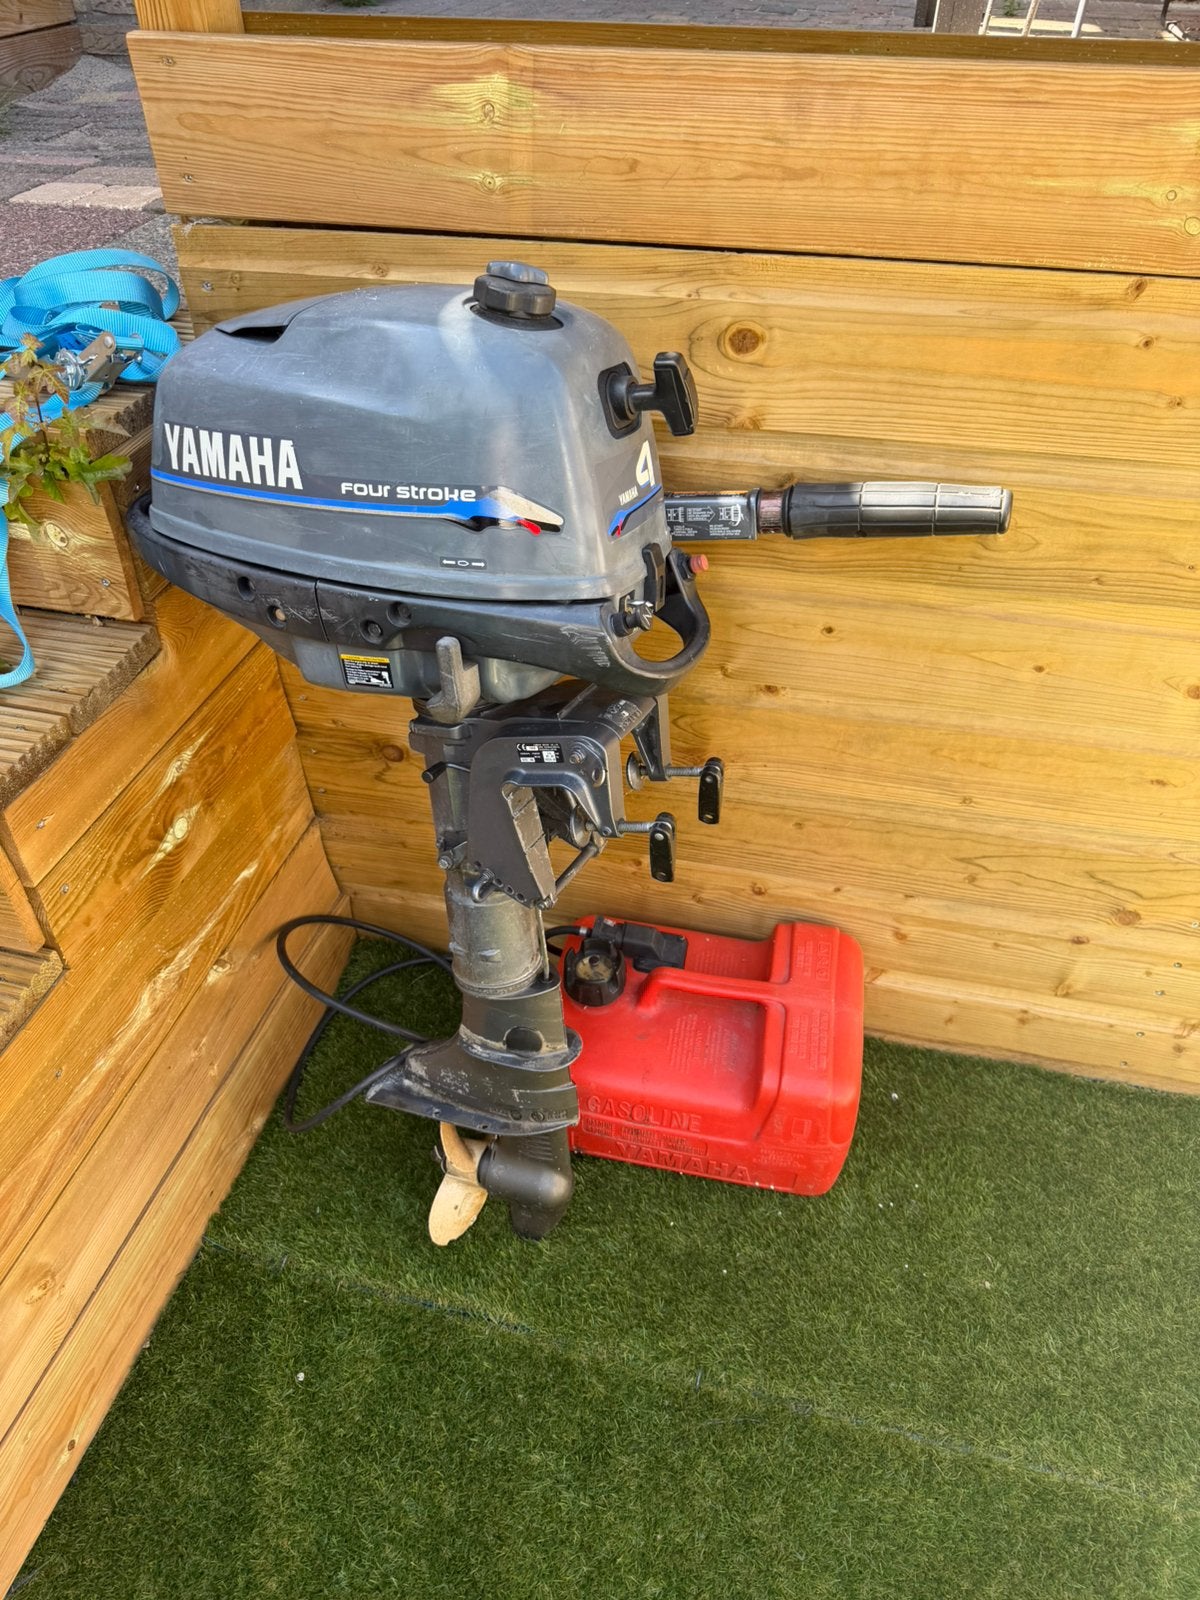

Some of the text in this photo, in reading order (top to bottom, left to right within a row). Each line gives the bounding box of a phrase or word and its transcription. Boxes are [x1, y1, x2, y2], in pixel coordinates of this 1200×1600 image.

[164, 422, 304, 490] YAMAHA
[635, 440, 656, 487] 4
[618, 485, 639, 506] YAMAHA
[587, 1095, 702, 1133] GASOLINE
[616, 1141, 750, 1181] YAMAHA
